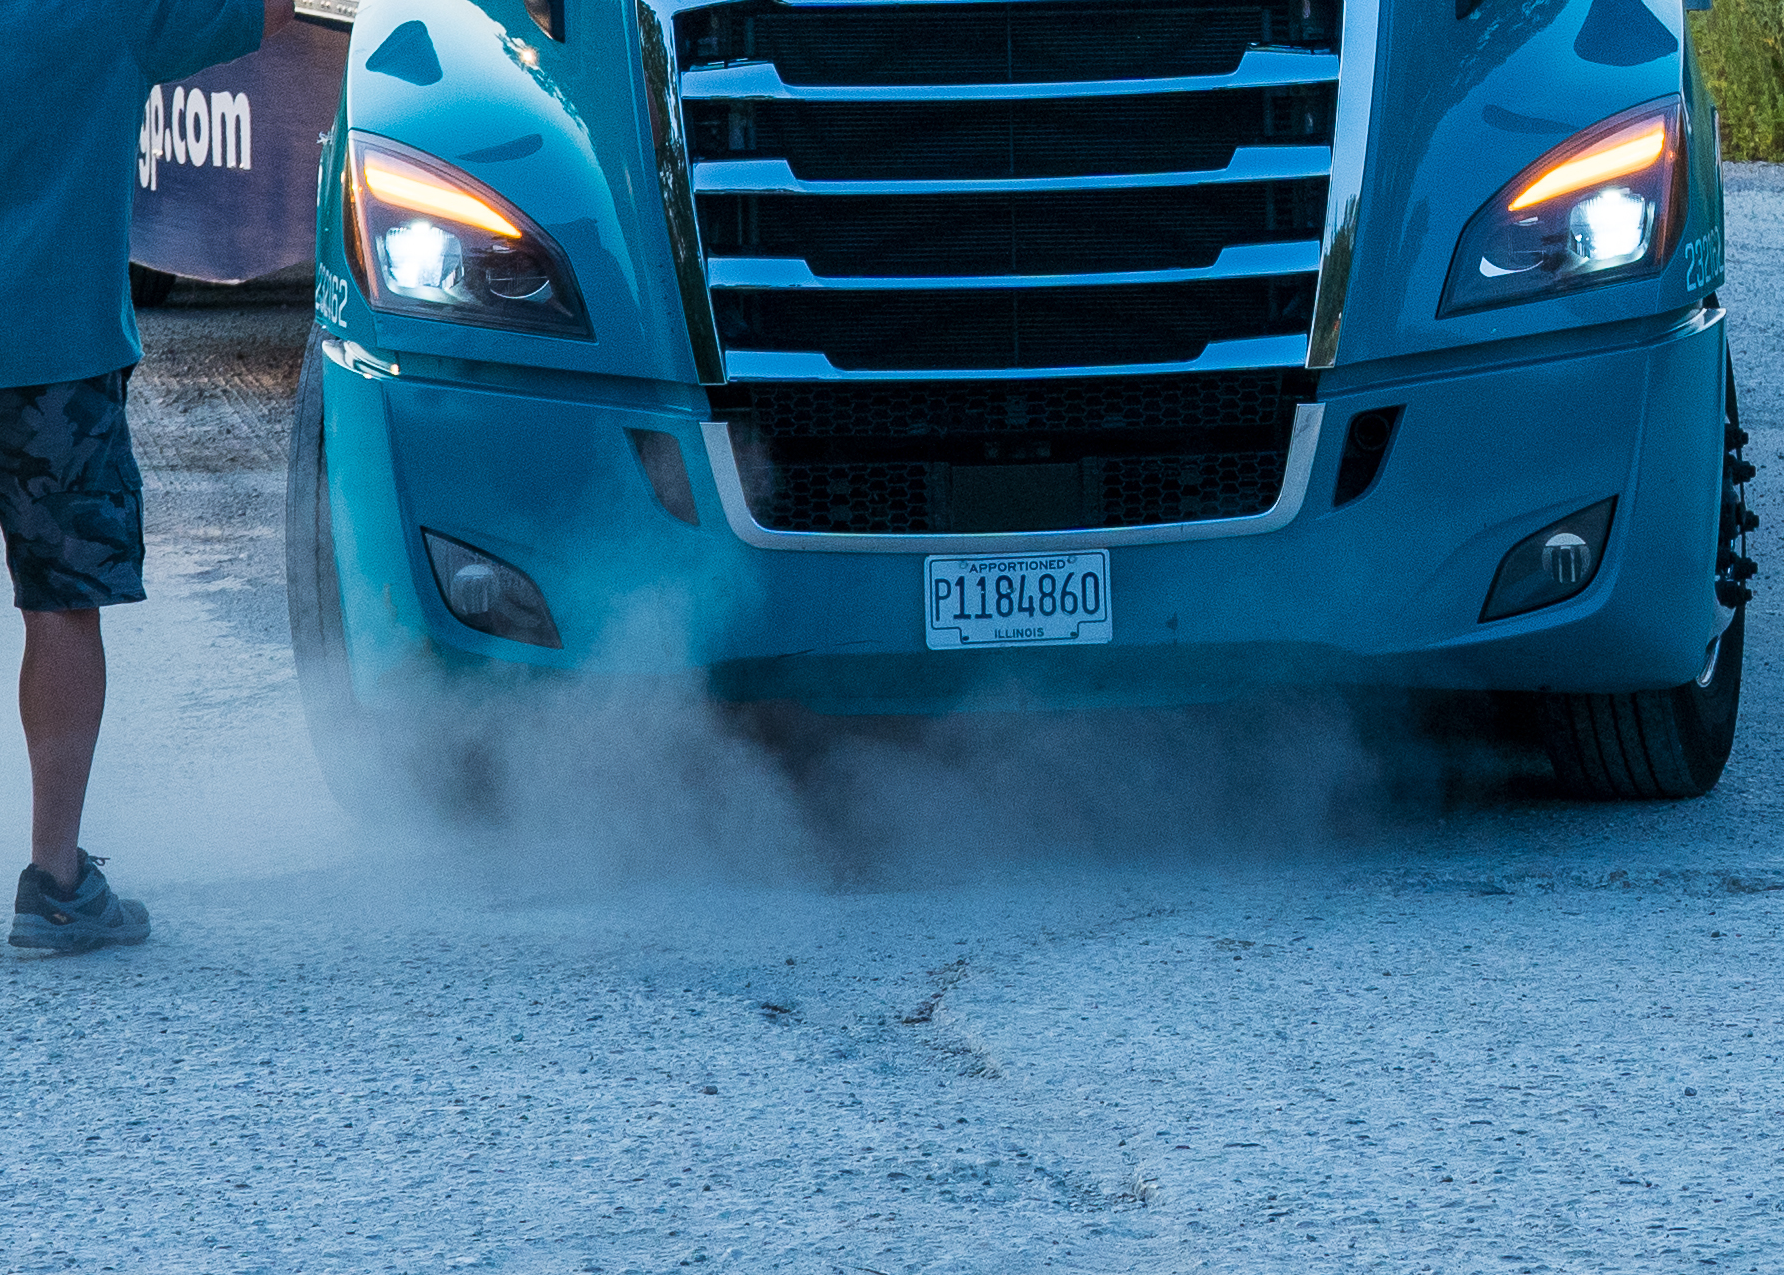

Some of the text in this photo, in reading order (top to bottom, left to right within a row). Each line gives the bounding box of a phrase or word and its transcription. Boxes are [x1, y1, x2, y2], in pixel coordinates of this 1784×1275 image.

[969, 559, 1067, 574] APPORTIONED
[934, 571, 1101, 622] P1184860
[994, 626, 1046, 639] ILLINOIS
